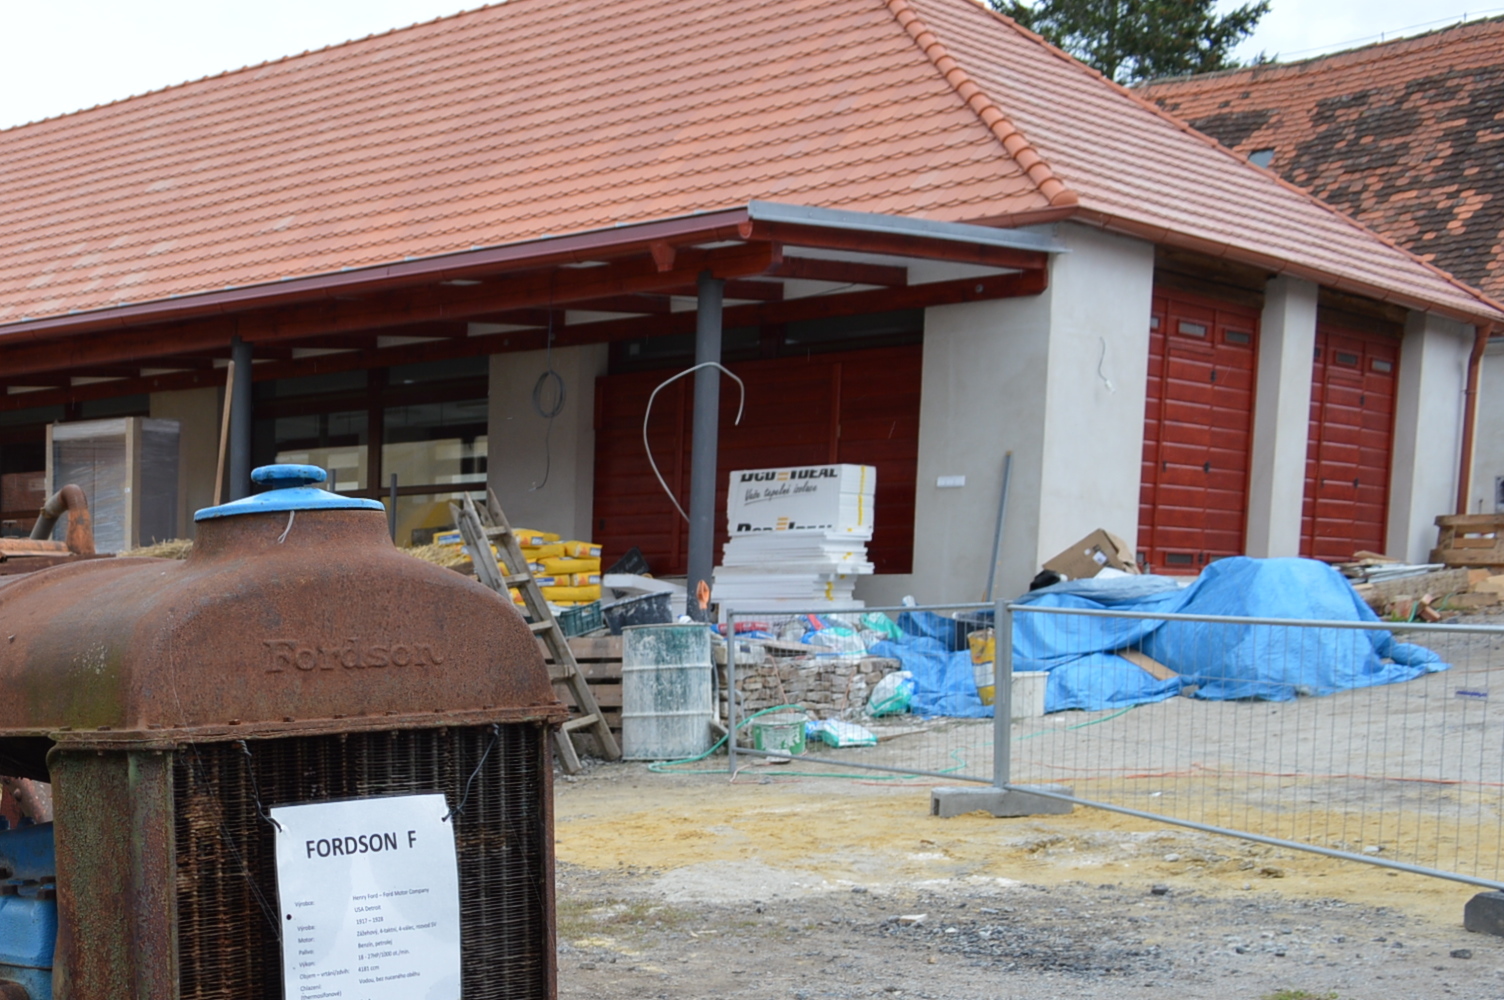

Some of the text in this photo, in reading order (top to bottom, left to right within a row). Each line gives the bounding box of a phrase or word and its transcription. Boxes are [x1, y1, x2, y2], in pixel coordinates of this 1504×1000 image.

[262, 637, 445, 674] Fordson
[306, 830, 416, 859] FORDSON F
[409, 887, 429, 895] Company
[354, 904, 381, 913] USA Detroit
[356, 917, 368, 925] 1917
[375, 938, 393, 948] petrolej
[357, 965, 370, 973] 4181
[359, 977, 375, 985] Vodou,
[384, 973, 406, 981] nuceného
